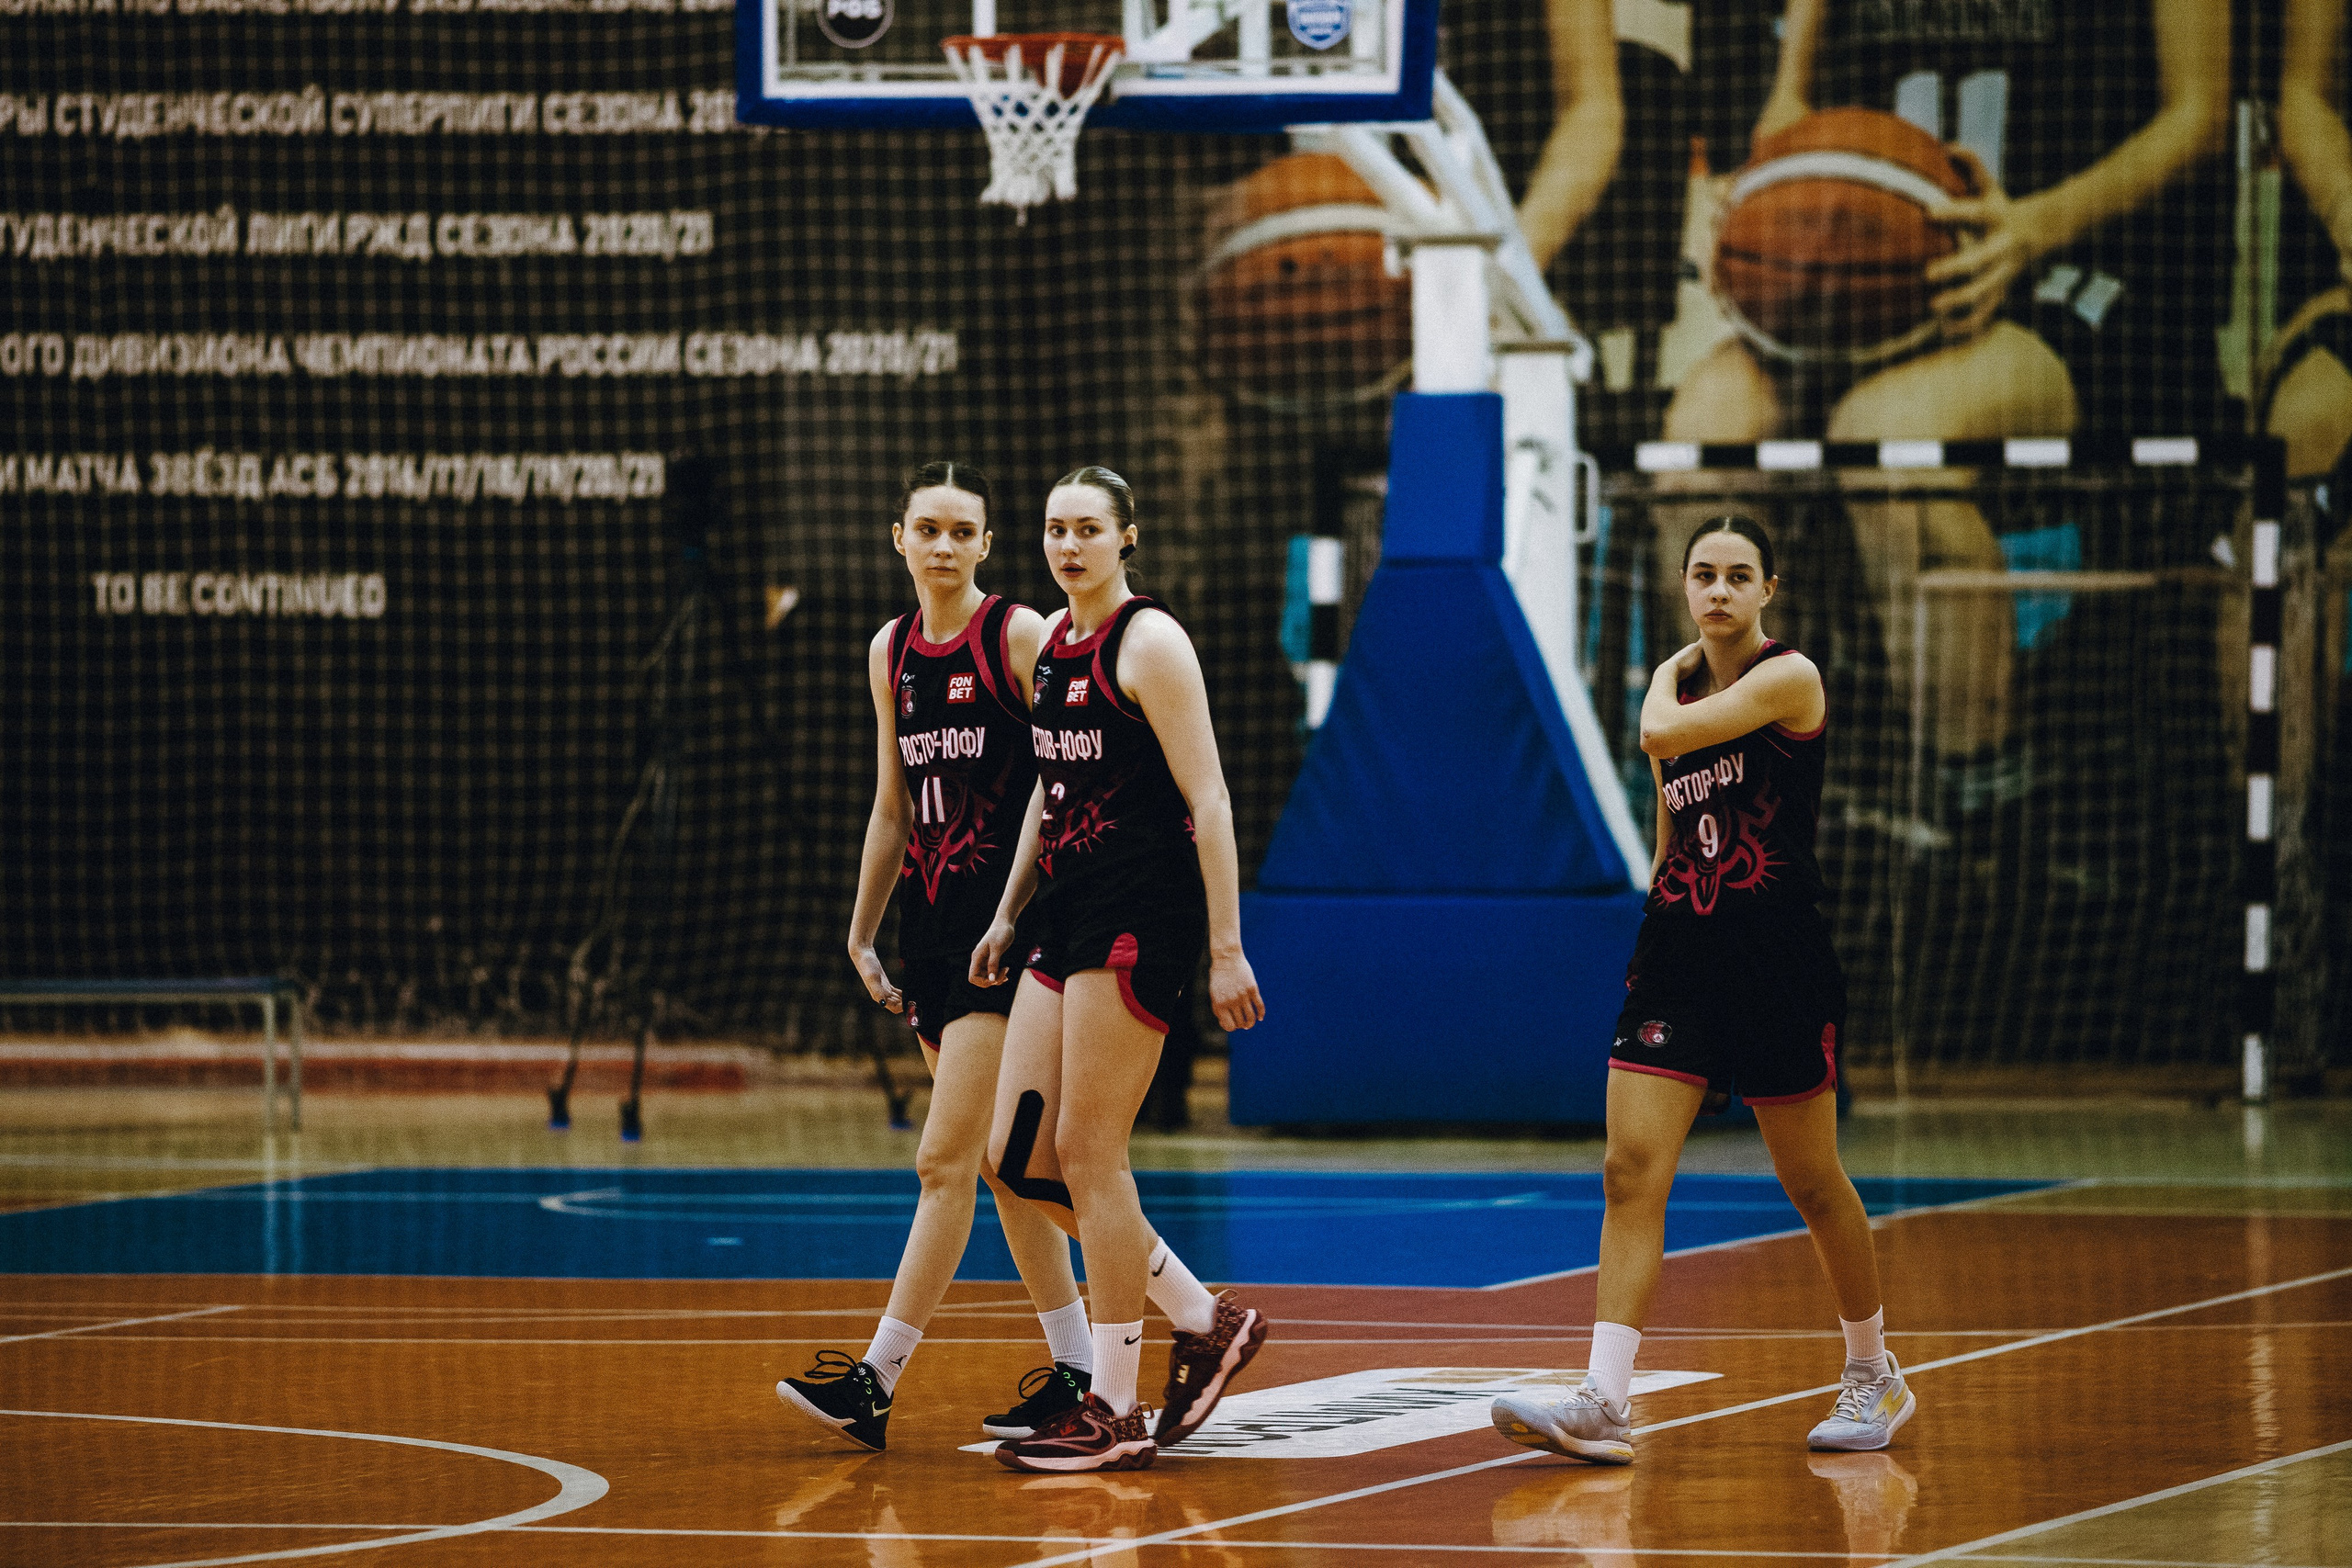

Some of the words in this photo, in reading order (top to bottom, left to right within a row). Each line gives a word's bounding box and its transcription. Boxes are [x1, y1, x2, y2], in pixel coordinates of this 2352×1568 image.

[55, 85, 324, 141] СТУДЕНЧЕСКОЙ
[542, 92, 683, 134] СЕЗОНА
[345, 211, 432, 262] РЖД
[436, 212, 577, 256] СЕЗОНА
[70, 333, 291, 382] ДИВИЗИОНА
[293, 333, 532, 377] ЧЕМПИОНАТА
[536, 333, 681, 378] РОССИИ
[687, 333, 822, 376] СЕЗОНА
[25, 454, 141, 494] МАТЧА
[267, 454, 338, 497] АСБ
[95, 571, 136, 615] TO
[141, 571, 187, 615] BE
[191, 571, 386, 618] CONTINUED
[949, 687, 973, 699] BET
[950, 676, 973, 688] FON
[1066, 691, 1088, 703] BET
[922, 776, 945, 824] 11
[1698, 814, 1719, 858] 9
